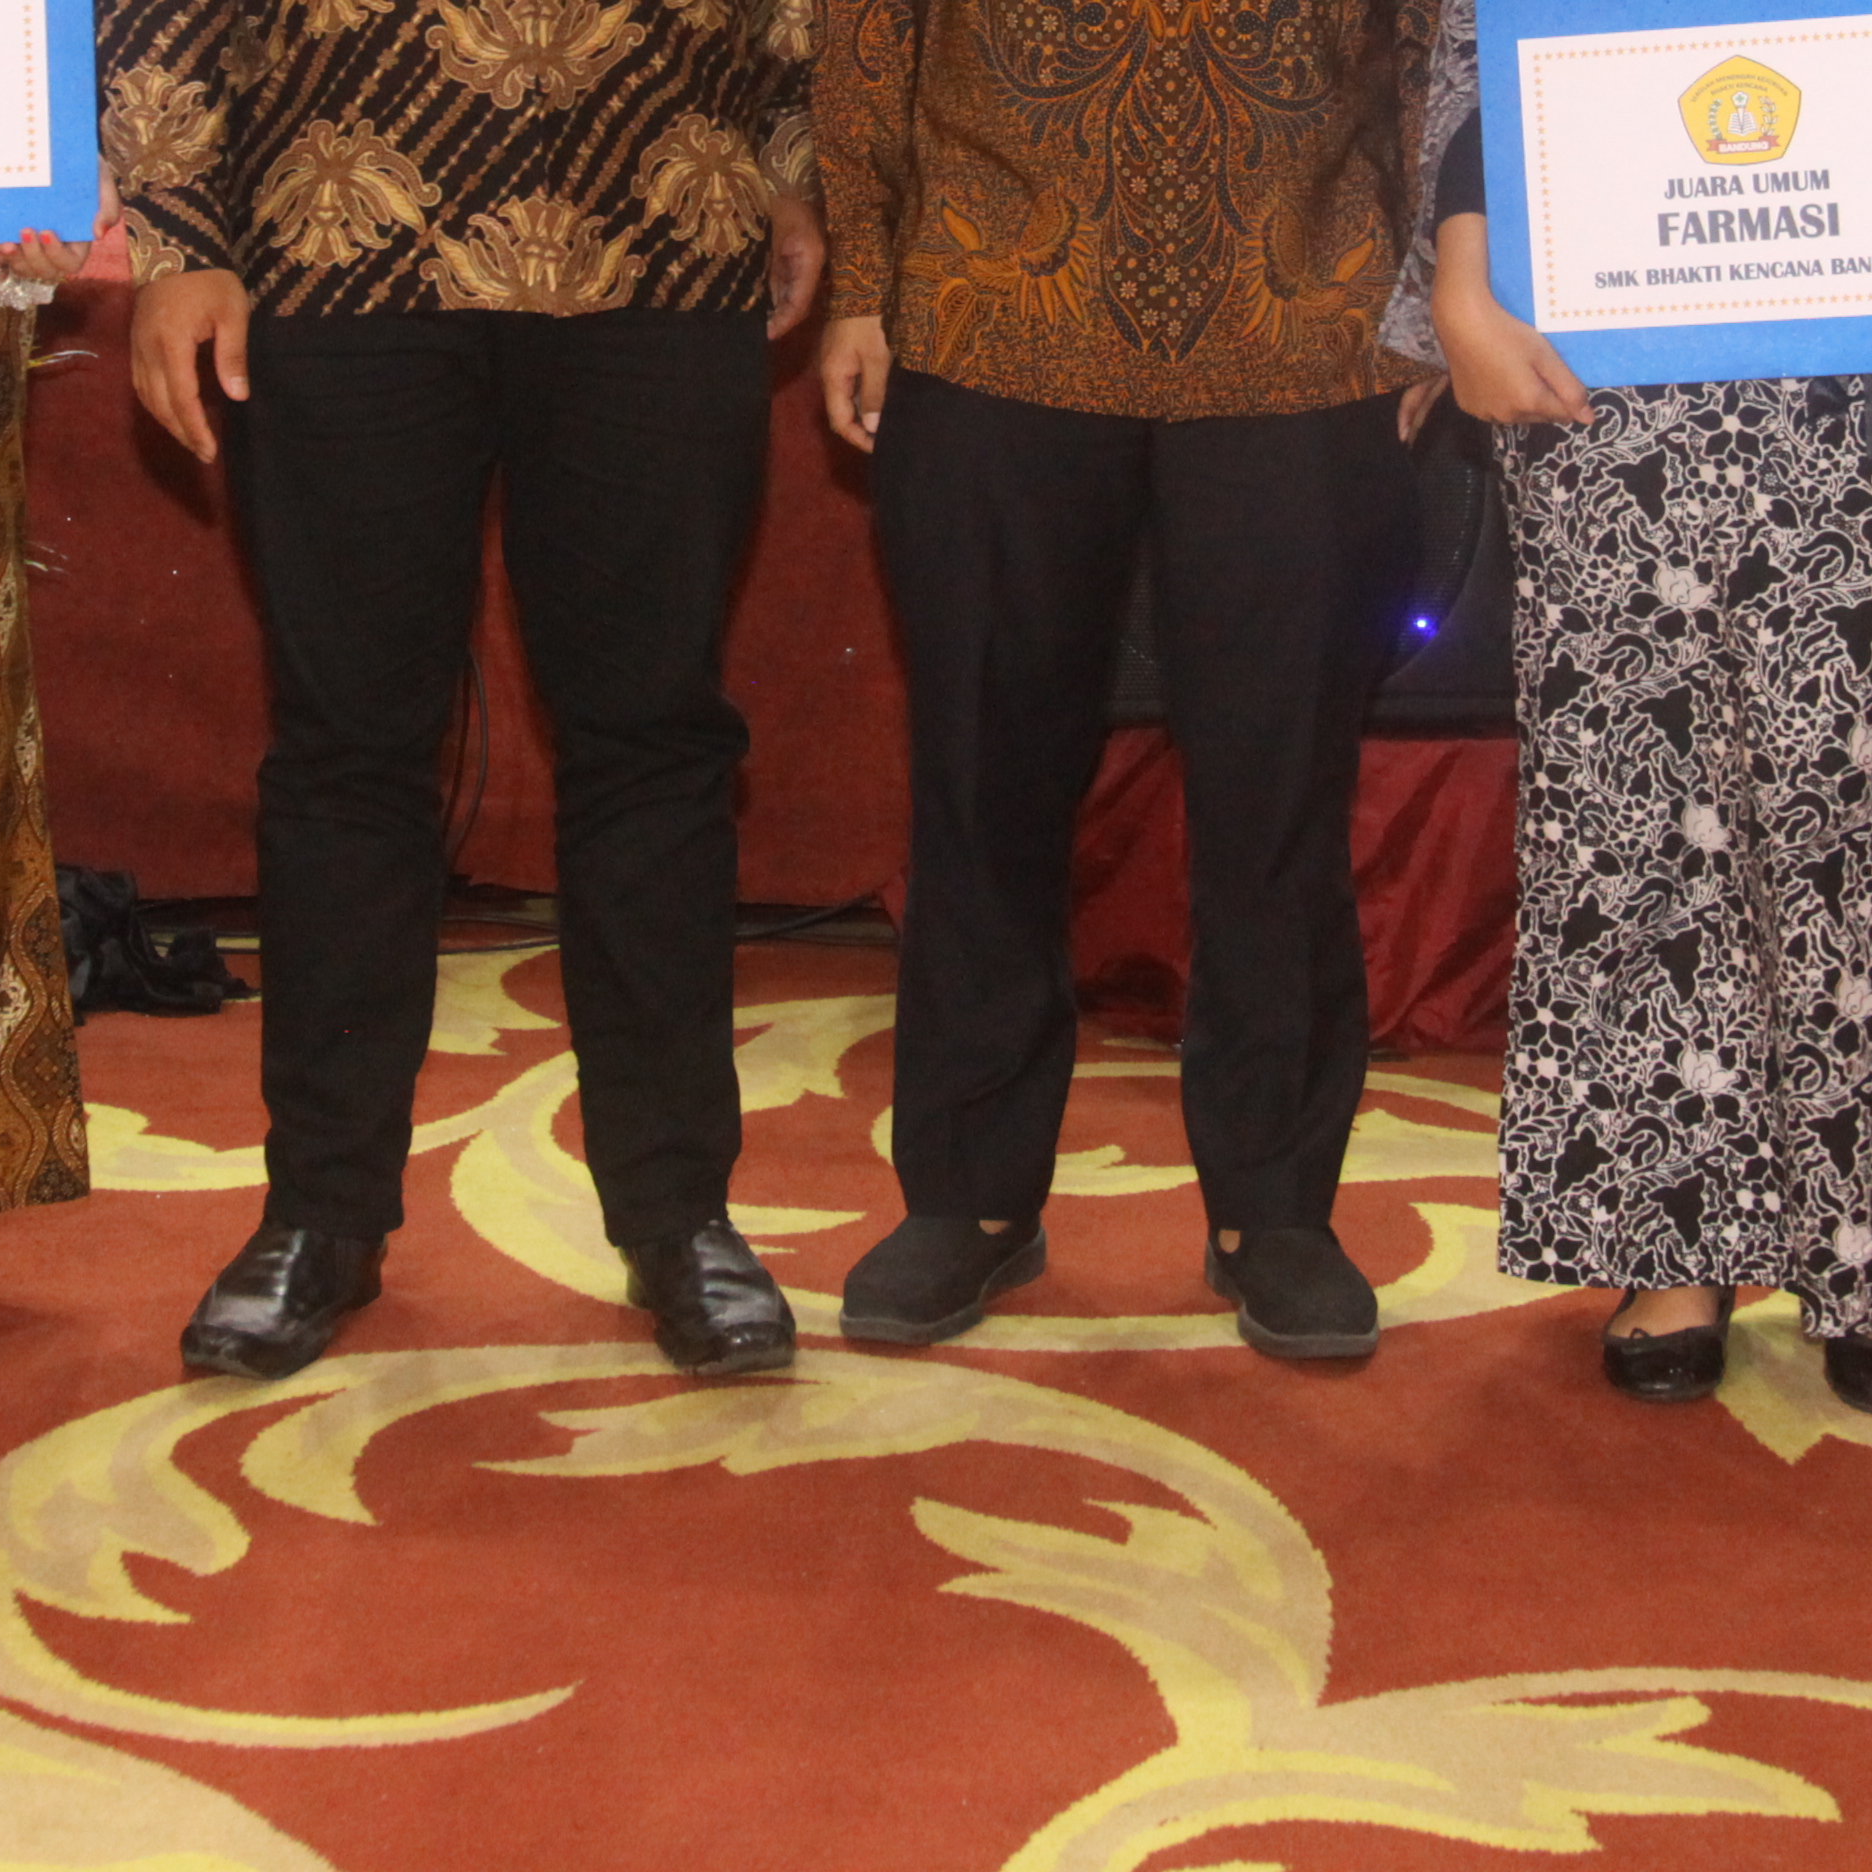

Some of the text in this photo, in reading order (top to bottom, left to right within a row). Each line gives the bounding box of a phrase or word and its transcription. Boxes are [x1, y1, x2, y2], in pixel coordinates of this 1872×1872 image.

[1663, 168, 1830, 200] JUARA UMUM
[1656, 202, 1841, 247] FARMASI
[1594, 270, 1640, 289] SMK
[1645, 264, 1722, 286] BHAKTI
[1728, 258, 1825, 282] KENCANA
